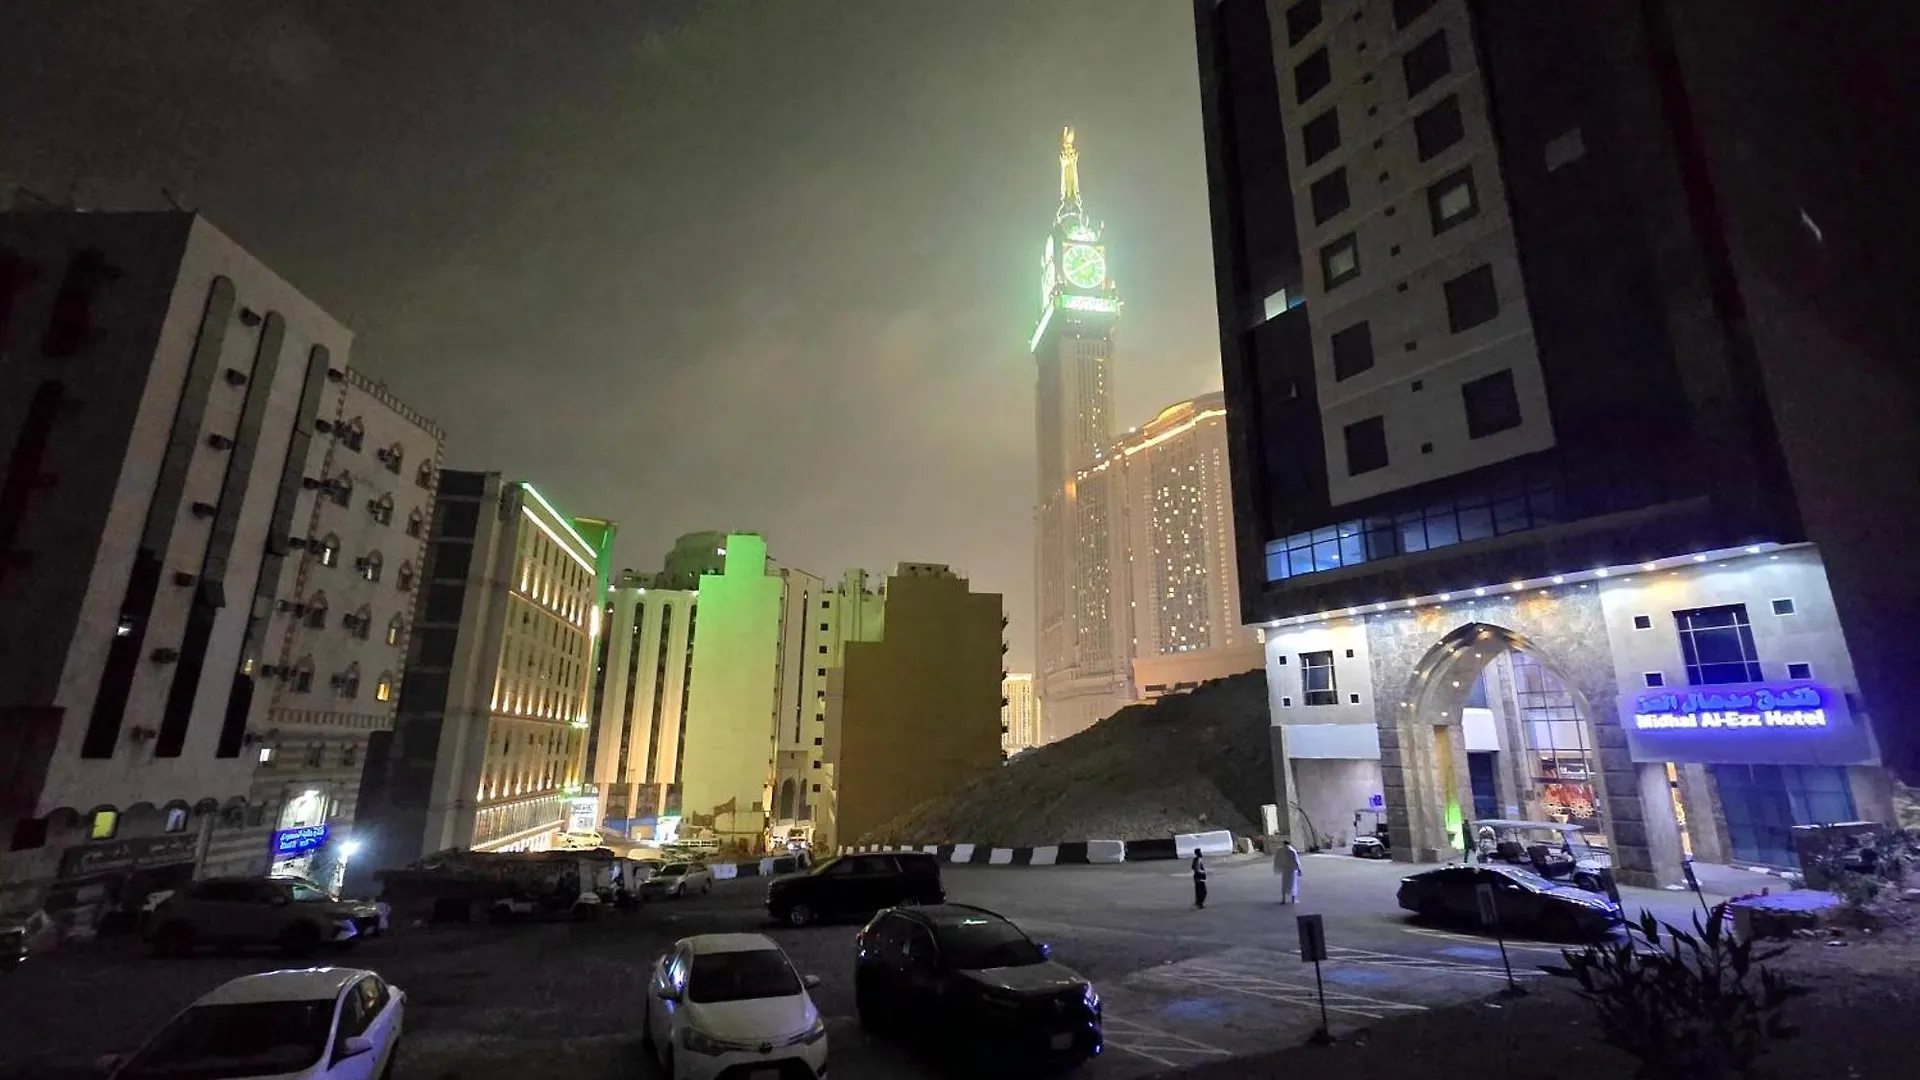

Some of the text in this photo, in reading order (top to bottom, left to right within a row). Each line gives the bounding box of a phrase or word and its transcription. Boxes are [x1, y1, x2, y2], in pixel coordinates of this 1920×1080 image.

[1755, 686, 1821, 711] فندق
[1701, 711, 1762, 727] Al-Ezz
[1765, 709, 1826, 726] Hotel
